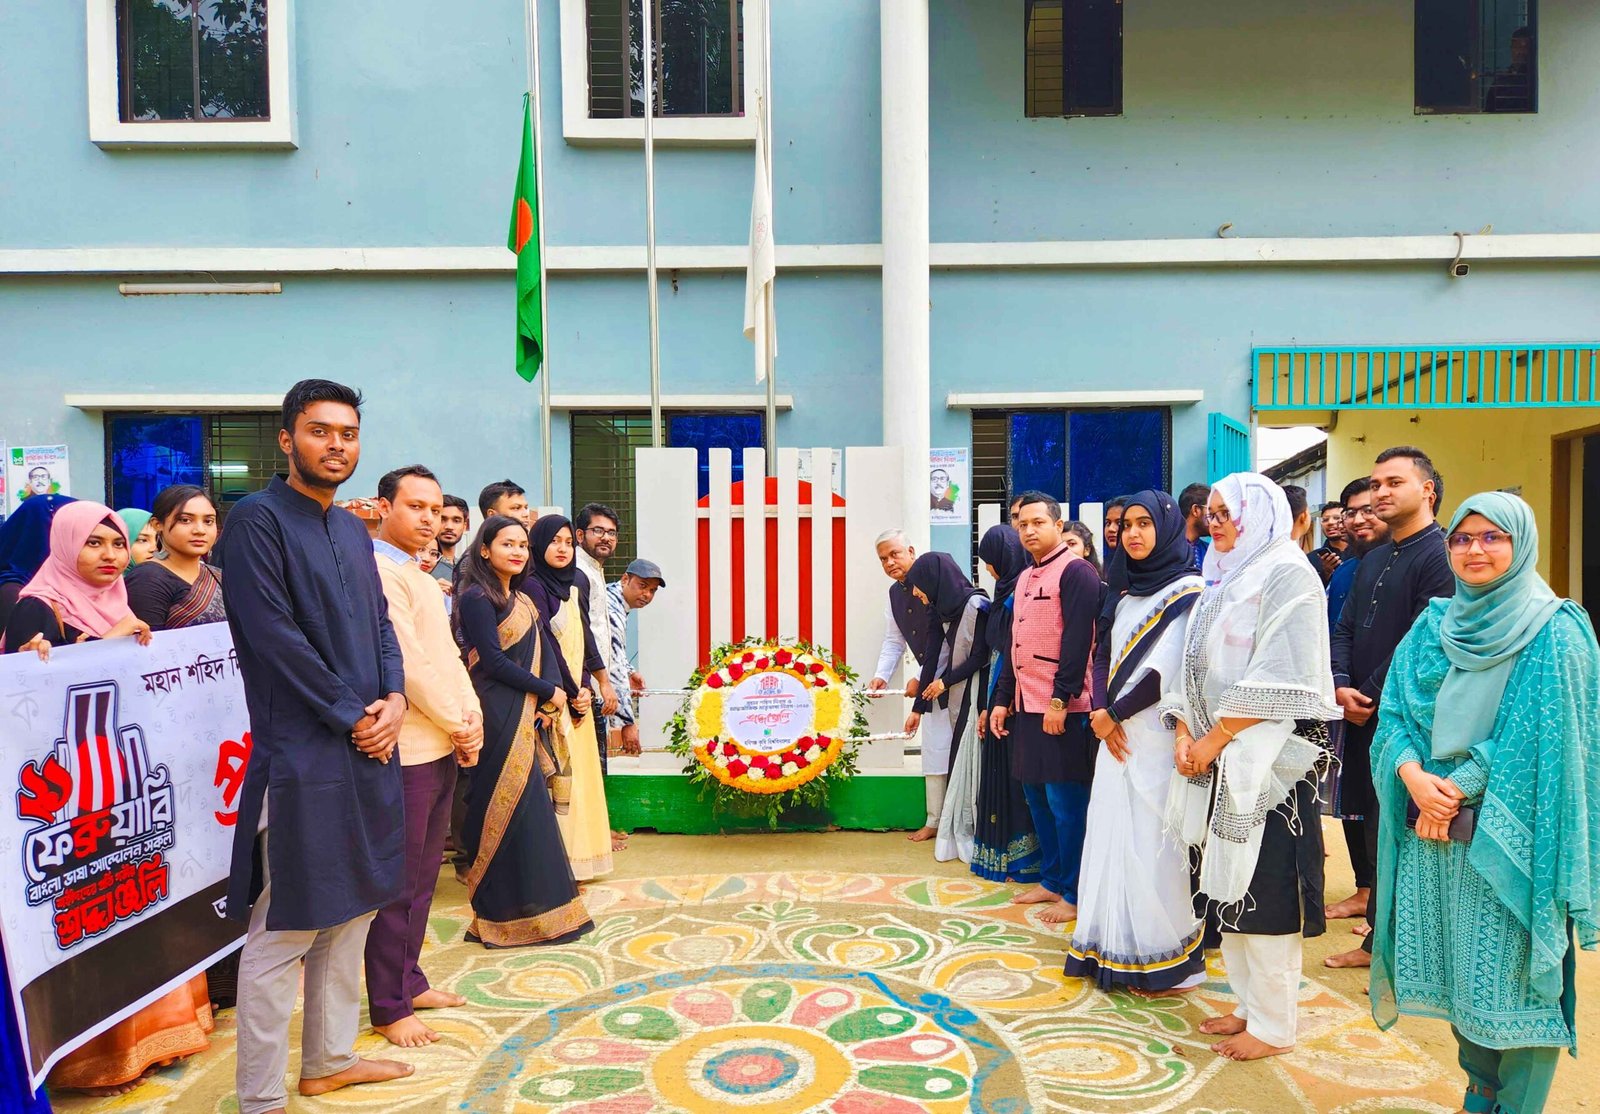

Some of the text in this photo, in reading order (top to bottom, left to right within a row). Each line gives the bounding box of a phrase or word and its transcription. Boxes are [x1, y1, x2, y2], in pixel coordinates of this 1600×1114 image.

[140, 667, 183, 695] মহান
[184, 653, 225, 685] শহিদ
[26, 764, 173, 881] ফেব্রুয়ারি
[29, 832, 173, 901] বাংলা ভাষা আন্দোলন সকল
[55, 853, 168, 945] শ্রদ্ধাঞ্জলি
